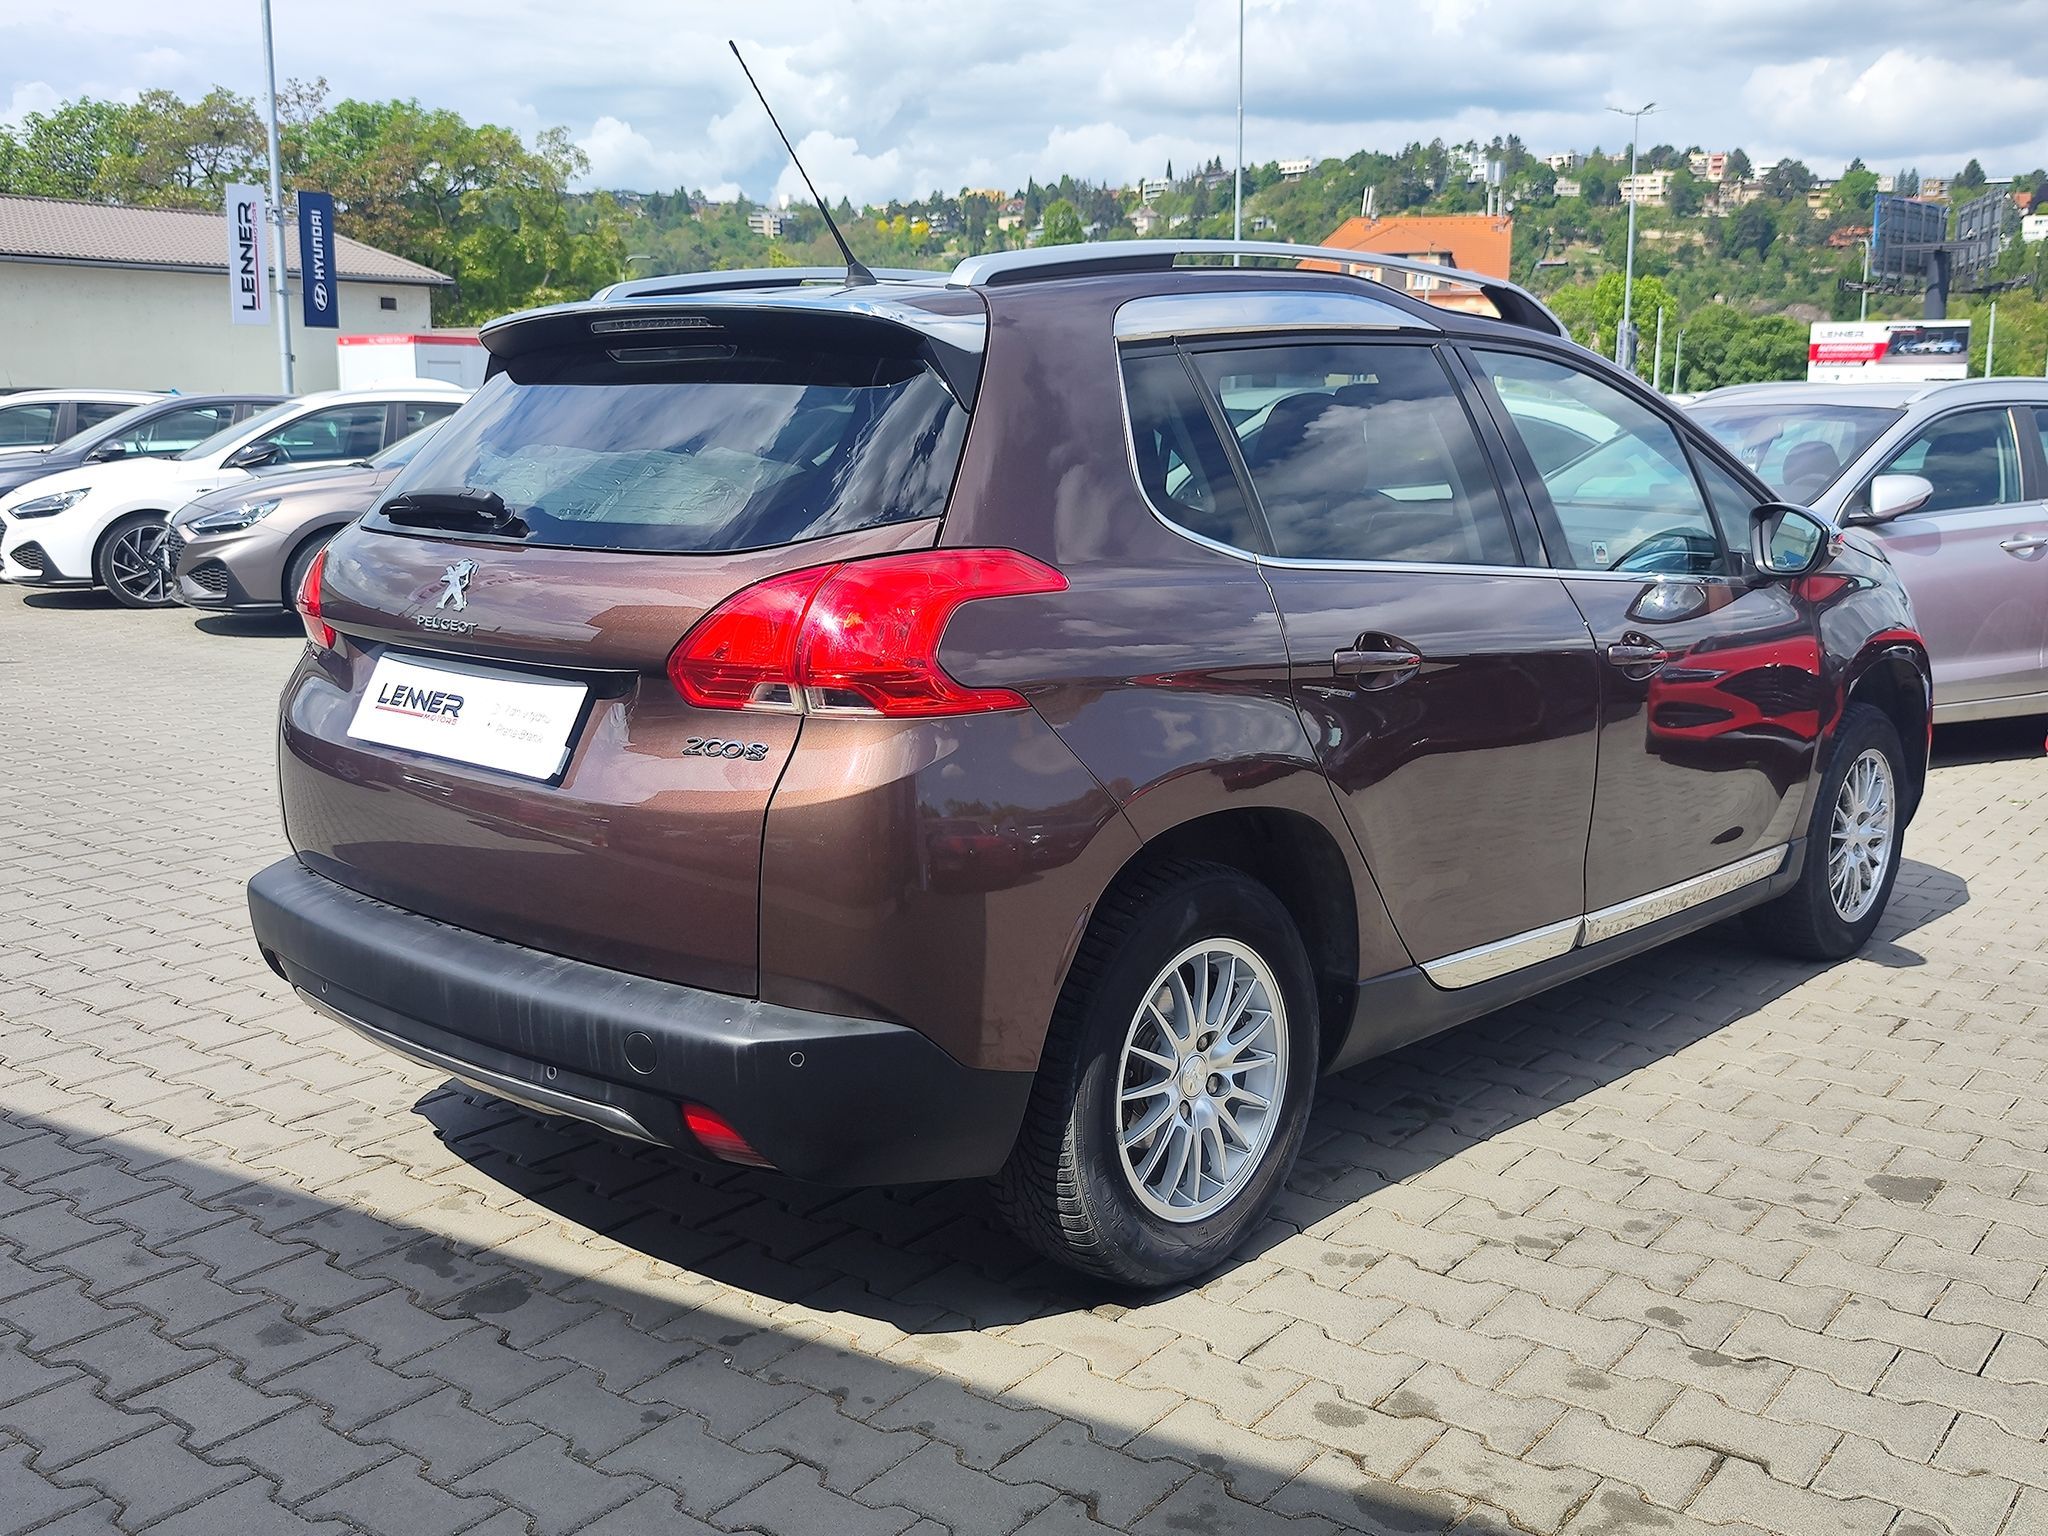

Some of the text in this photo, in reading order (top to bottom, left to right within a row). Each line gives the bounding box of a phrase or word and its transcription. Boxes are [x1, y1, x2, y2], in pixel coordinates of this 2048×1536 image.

[237, 201, 256, 311] LENNER
[311, 209, 325, 280] HYUNDAI
[416, 614, 479, 636] PEUGEOT
[377, 682, 464, 718] LENNER
[423, 713, 458, 726] MOTORS
[682, 736, 769, 761] 2008
